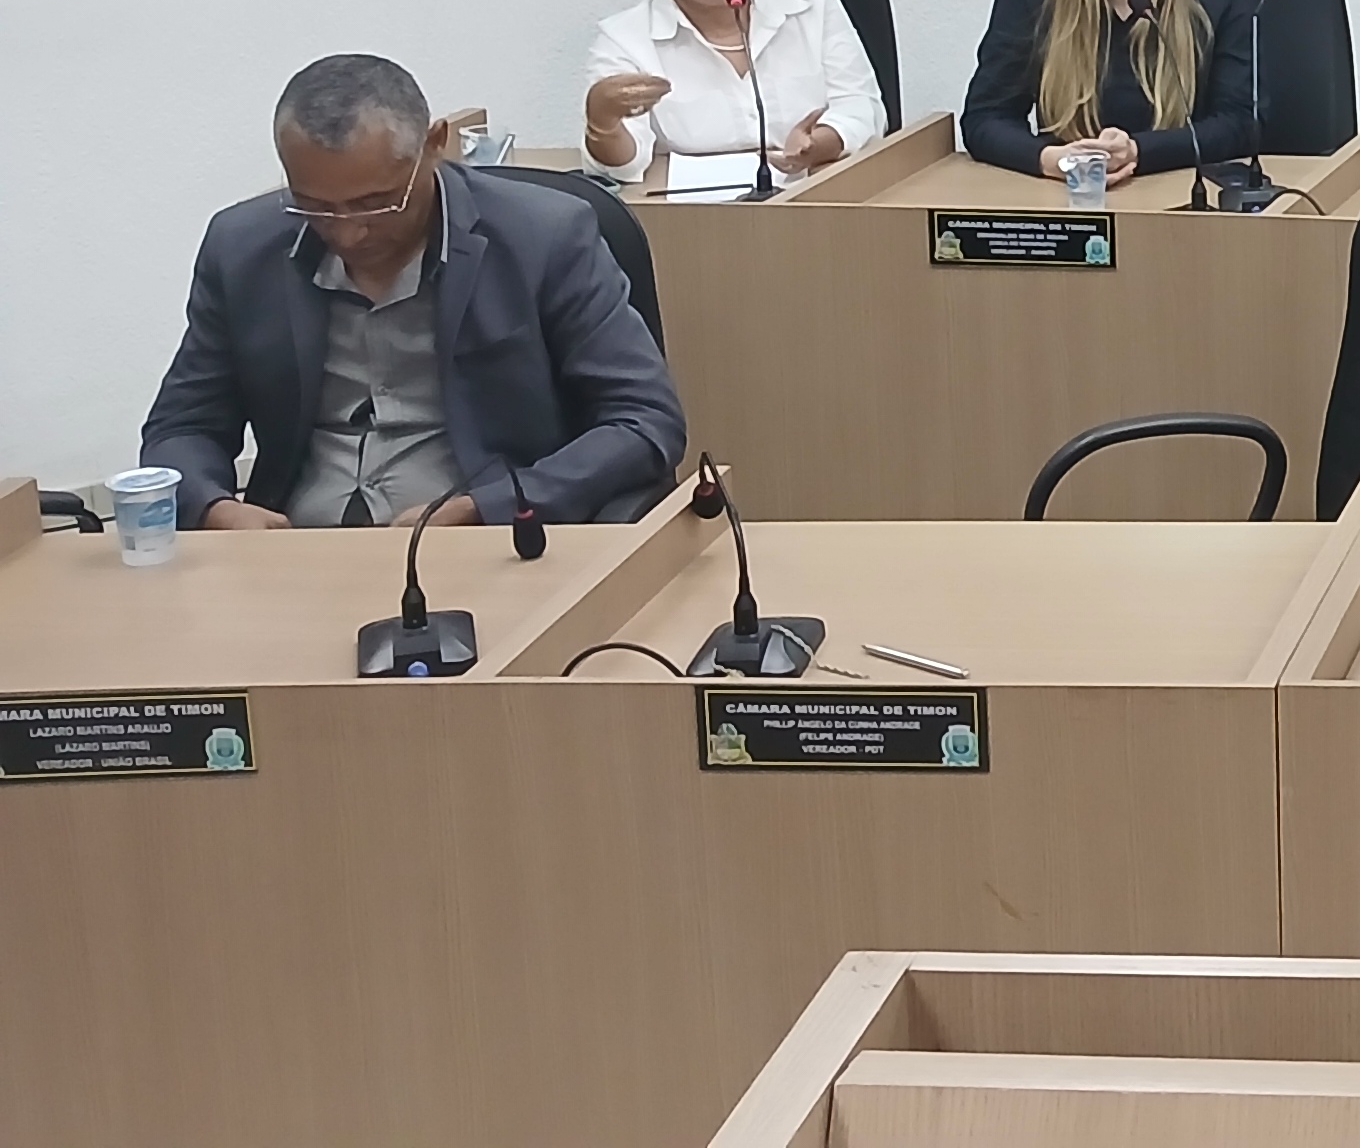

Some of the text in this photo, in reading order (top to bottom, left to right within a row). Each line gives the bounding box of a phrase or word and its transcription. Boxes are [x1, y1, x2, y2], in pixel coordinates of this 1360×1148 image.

[47, 706, 140, 720] MUNICIPAL
[143, 704, 167, 717] DE
[169, 703, 225, 716] TIMON
[725, 702, 958, 716] CÂMARA MUNICIPAL DE TIMON
